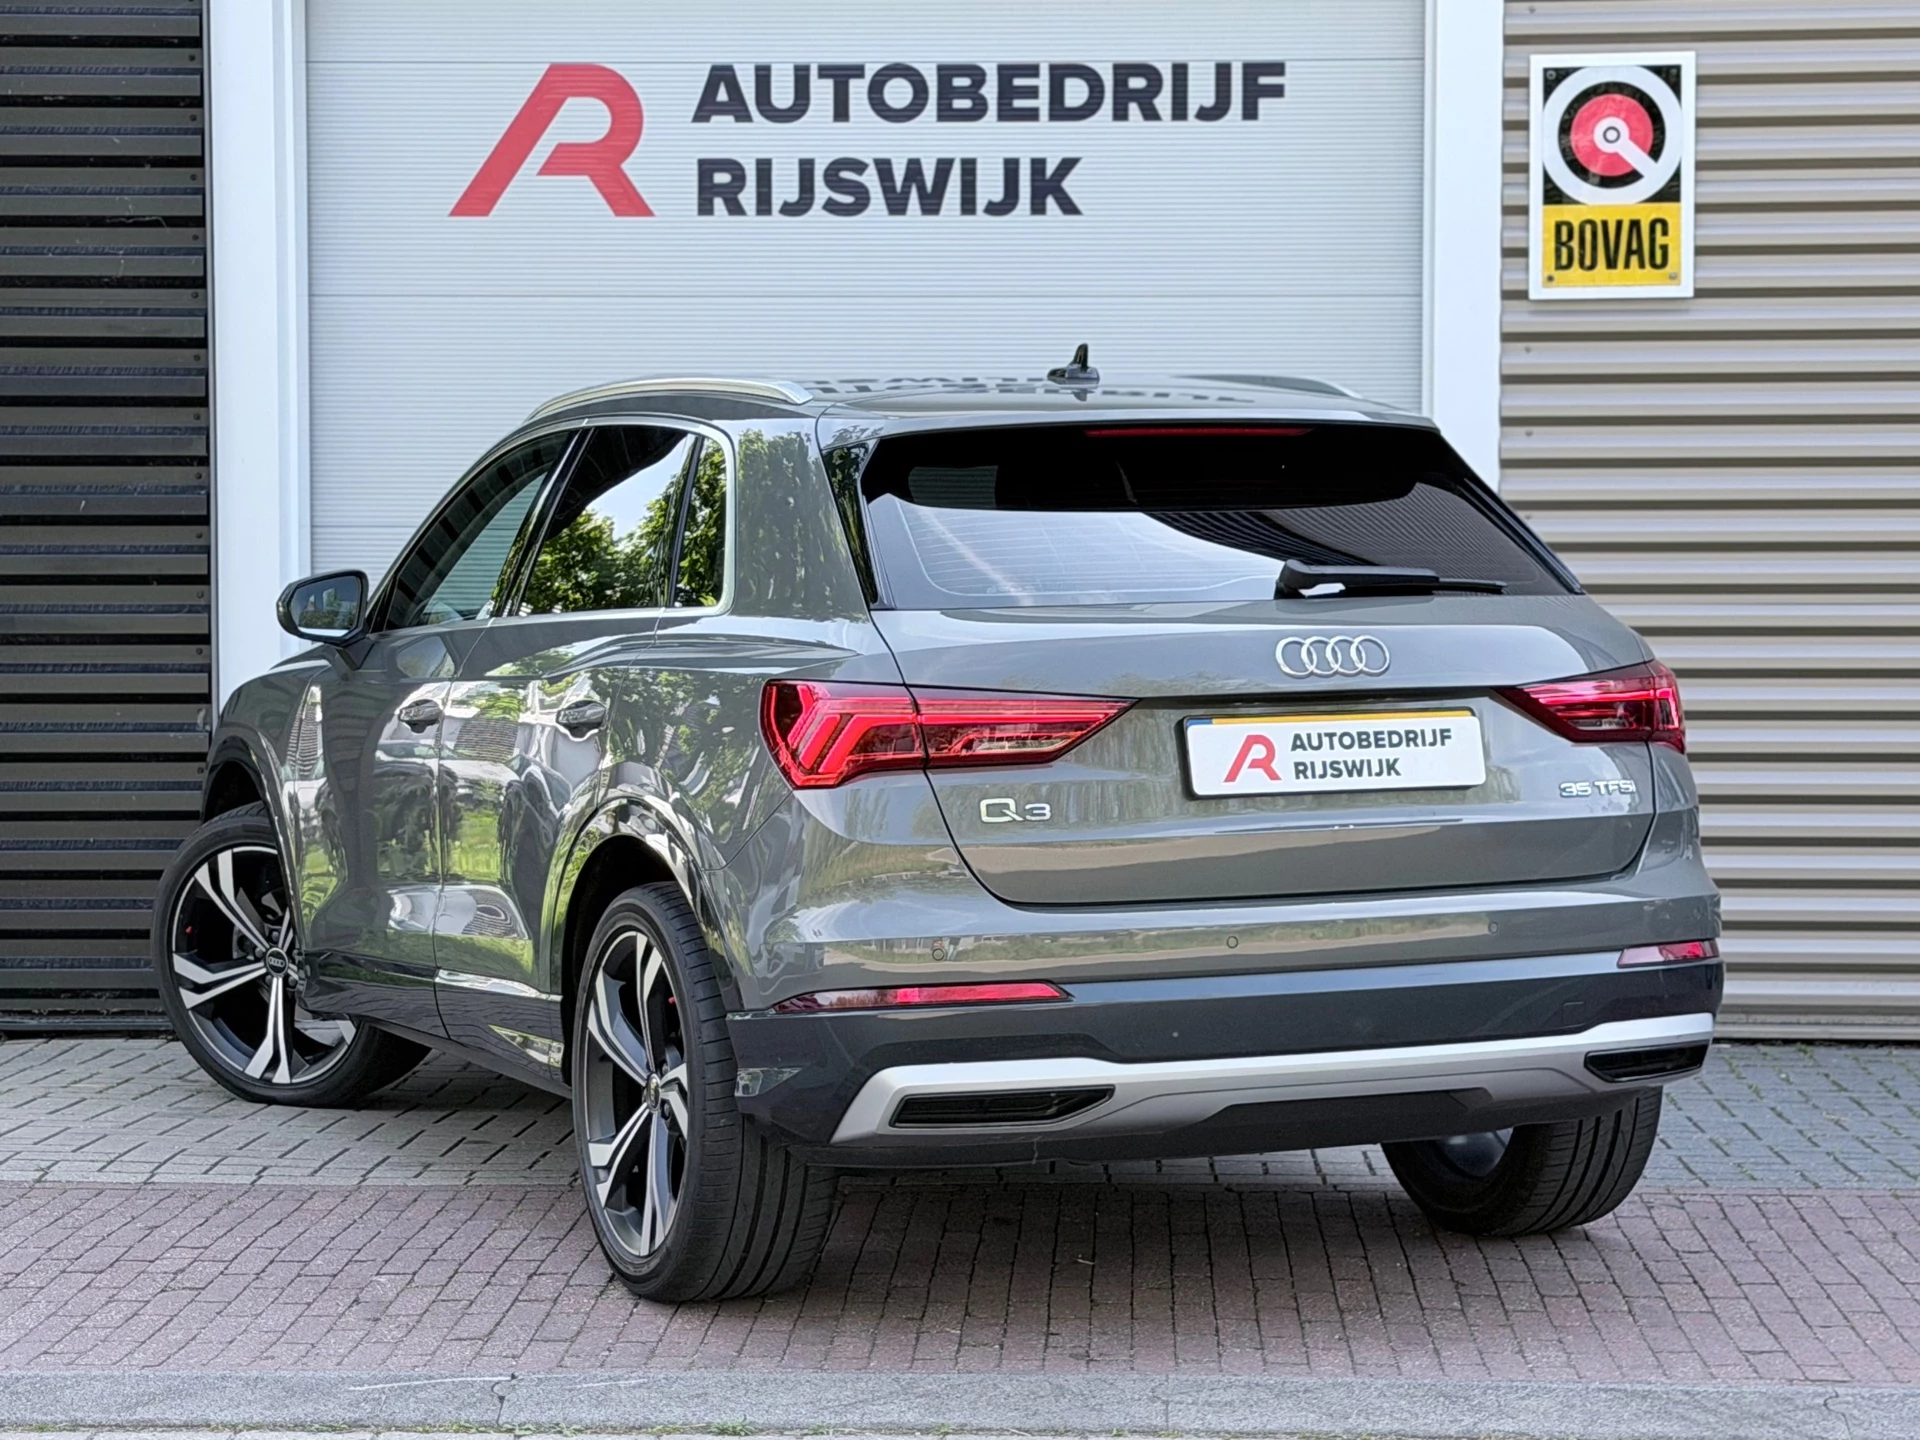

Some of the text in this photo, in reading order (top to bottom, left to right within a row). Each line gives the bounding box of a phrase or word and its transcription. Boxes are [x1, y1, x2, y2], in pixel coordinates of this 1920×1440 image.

[691, 62, 1286, 124] AUTOBEDRIJF
[697, 157, 1084, 218] RIJSWIJK
[1554, 217, 1670, 271] BOVAG
[1290, 728, 1452, 752] AUTOBEDRIJF
[1293, 757, 1402, 780] RIJSWIJK
[1559, 782, 1592, 798] 35
